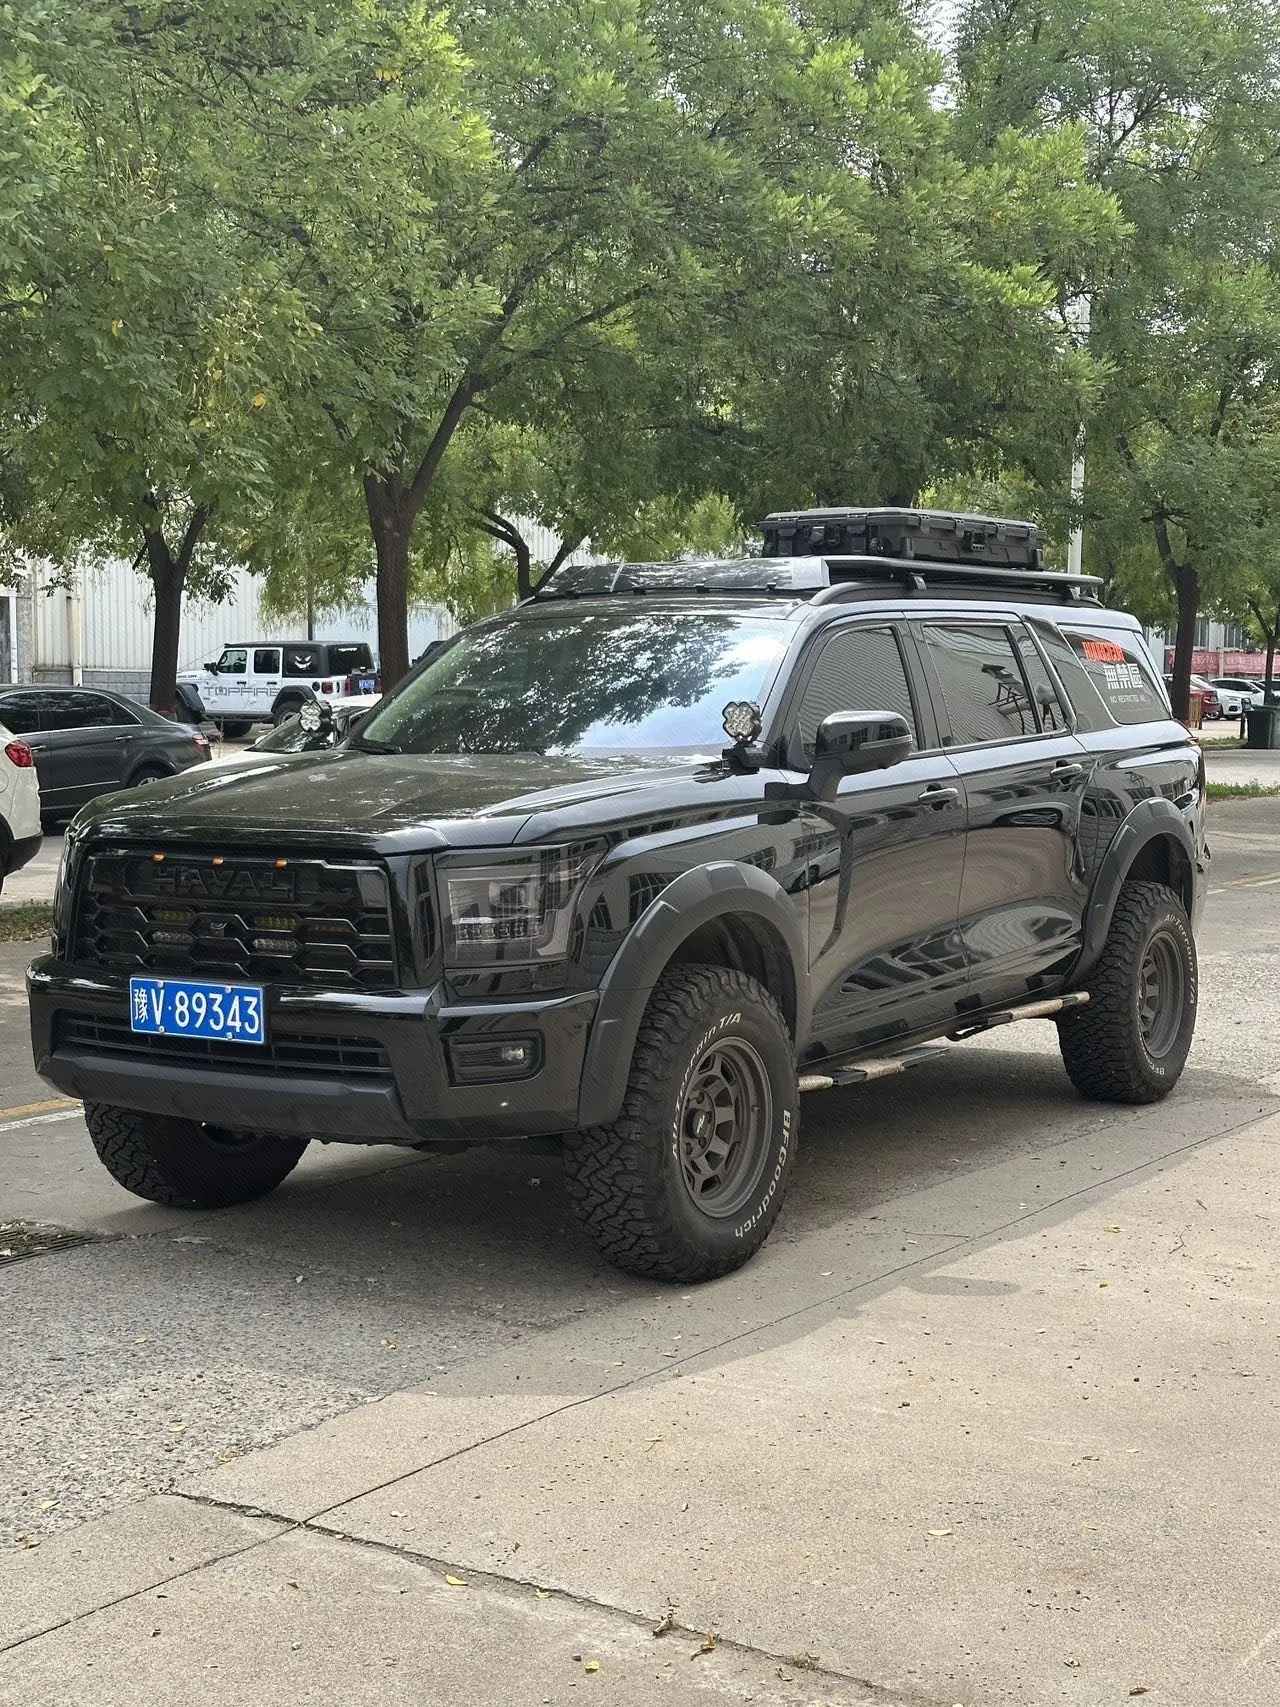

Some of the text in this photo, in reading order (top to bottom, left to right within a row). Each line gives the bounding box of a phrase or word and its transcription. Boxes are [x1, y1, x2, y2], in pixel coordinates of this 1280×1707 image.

[203, 686, 281, 697] TOPFIRE
[152, 864, 297, 900] HAVAL
[719, 1012, 742, 1029] T/A
[735, 1109, 792, 1239] BFGoodrich
